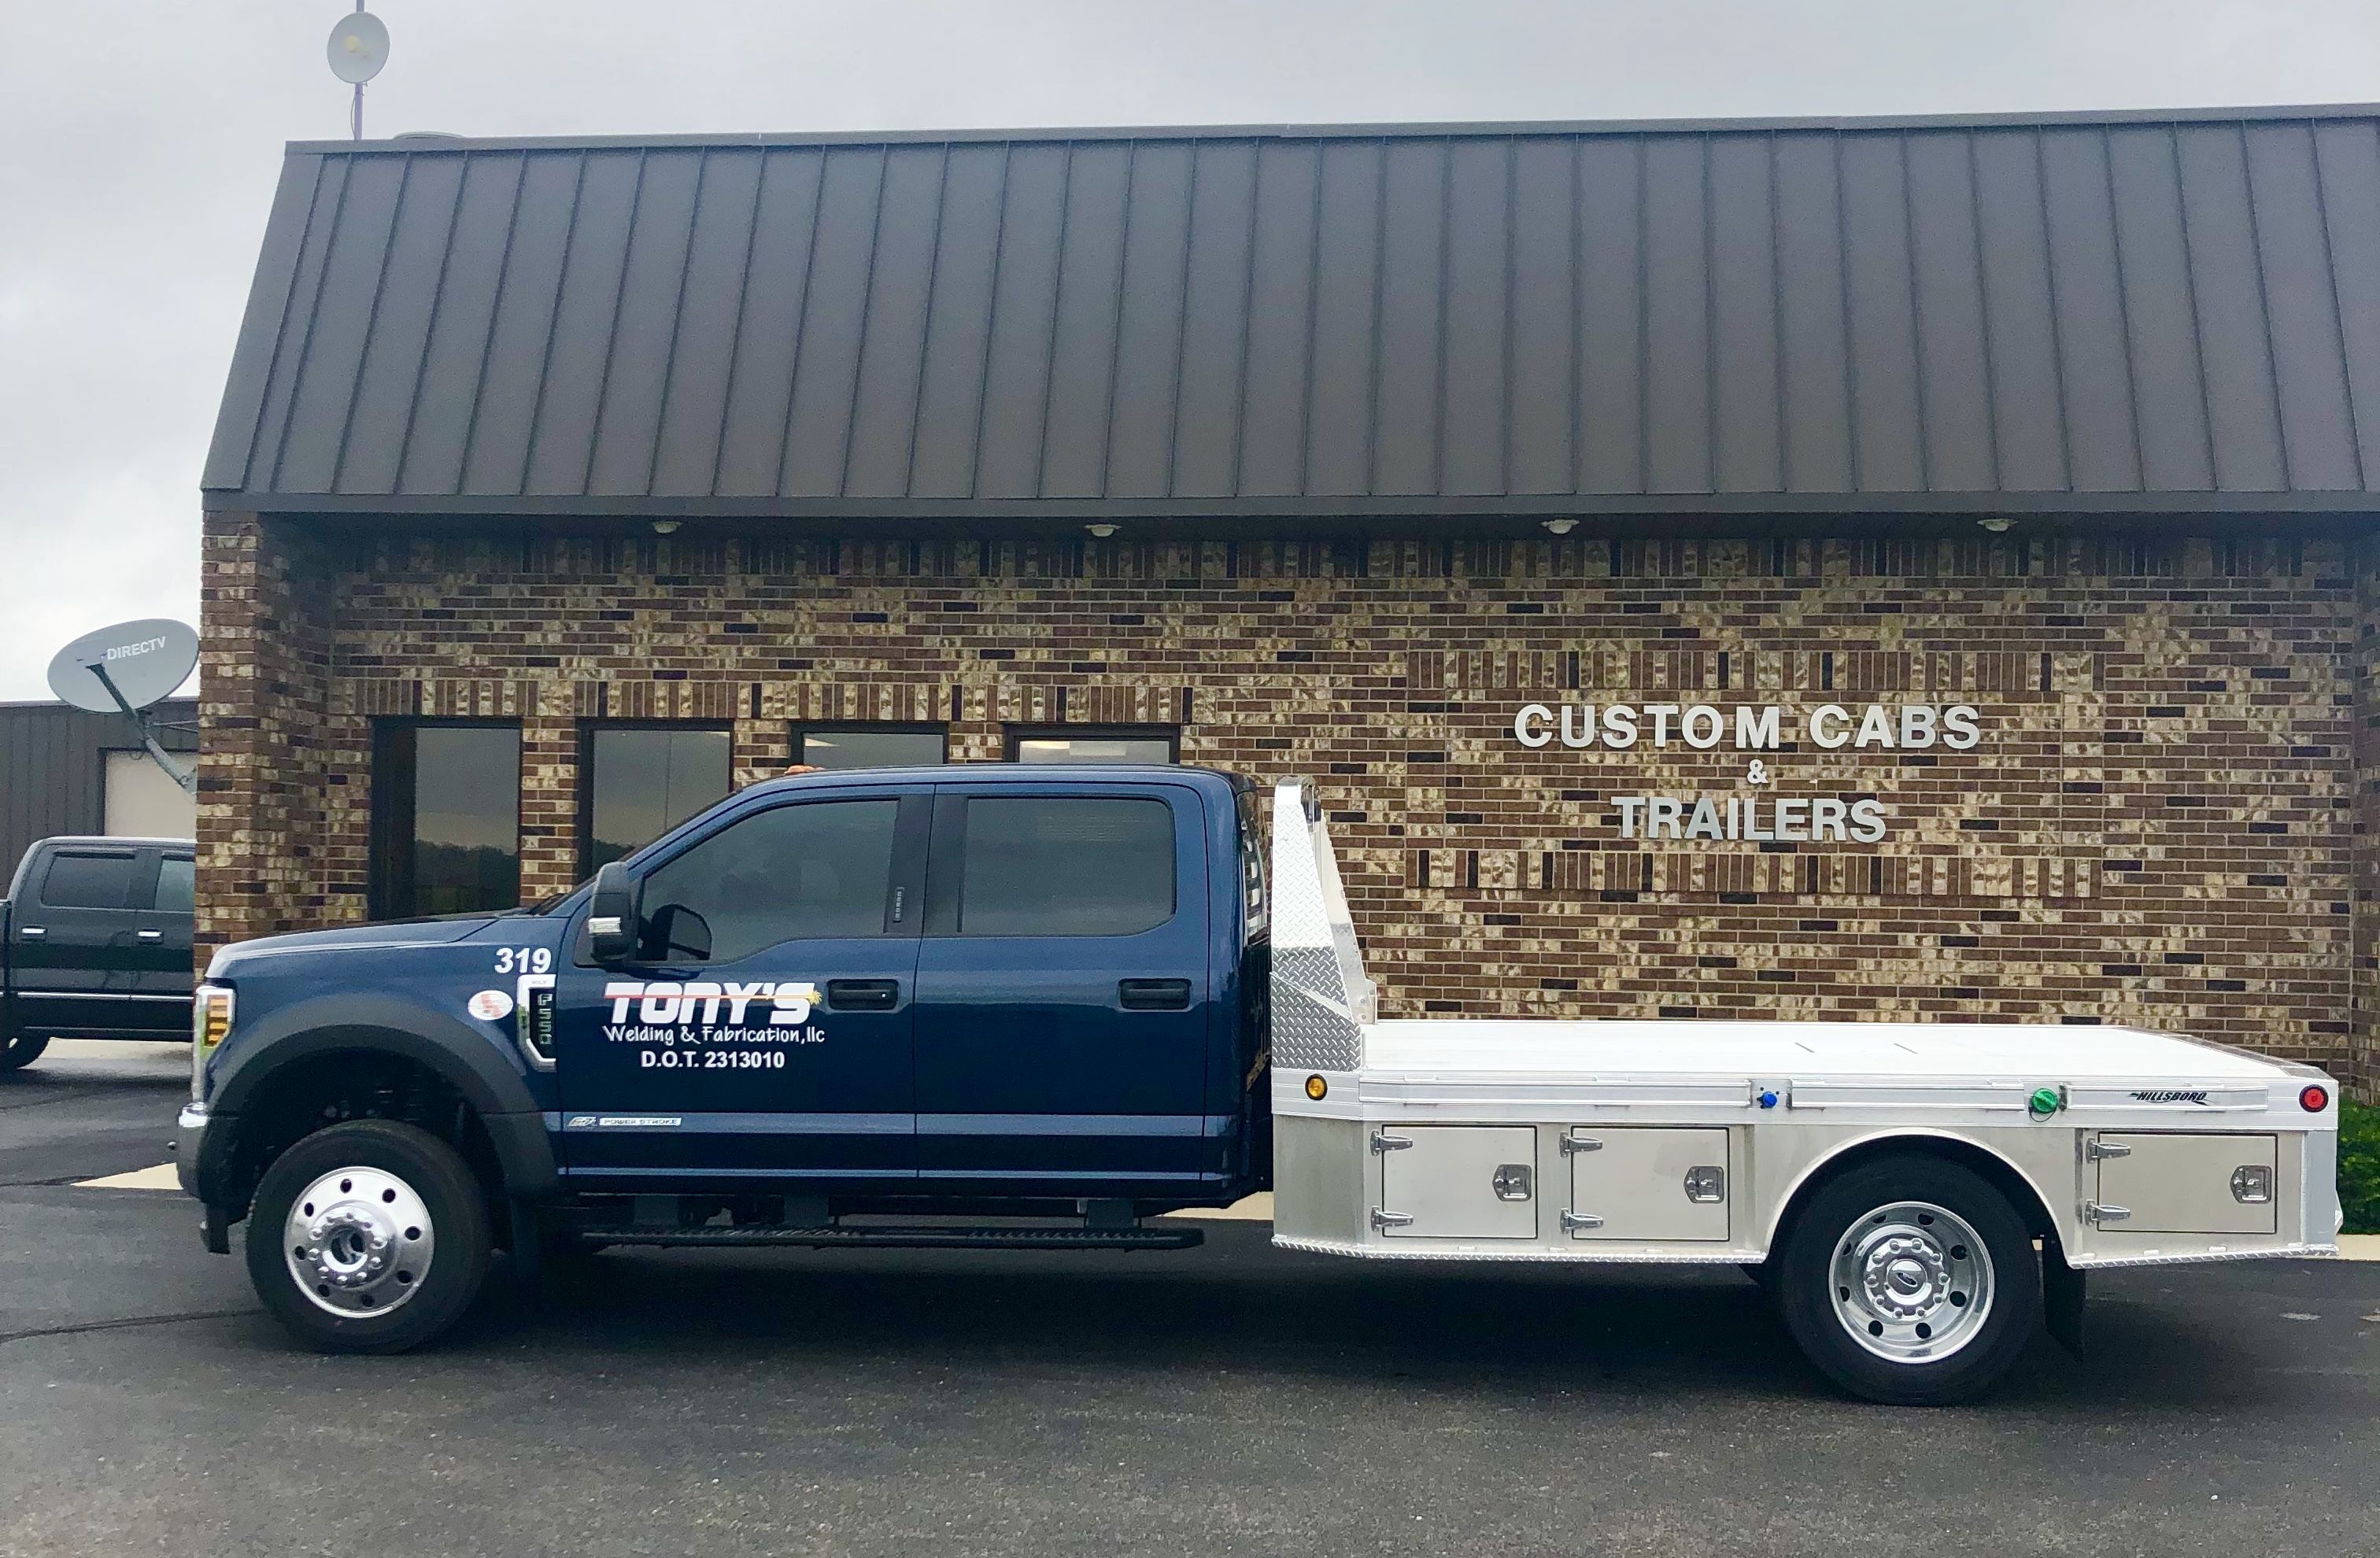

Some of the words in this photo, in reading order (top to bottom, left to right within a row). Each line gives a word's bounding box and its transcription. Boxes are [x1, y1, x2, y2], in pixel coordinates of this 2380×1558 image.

[106, 636, 166, 660] DIRECTV
[1514, 704, 1779, 749] CUSTOM
[1810, 704, 1980, 750] CABS
[1747, 759, 1768, 785] &
[1611, 796, 1887, 843] TRAILERS
[494, 947, 552, 973] 319
[604, 982, 815, 1024] TONY'S
[602, 1025, 674, 1045] Welding
[681, 1025, 701, 1044] &
[641, 1050, 700, 1068] D.O.T.
[704, 1050, 785, 1069] 2313010
[2135, 1091, 2208, 1101] HILLSBORO
